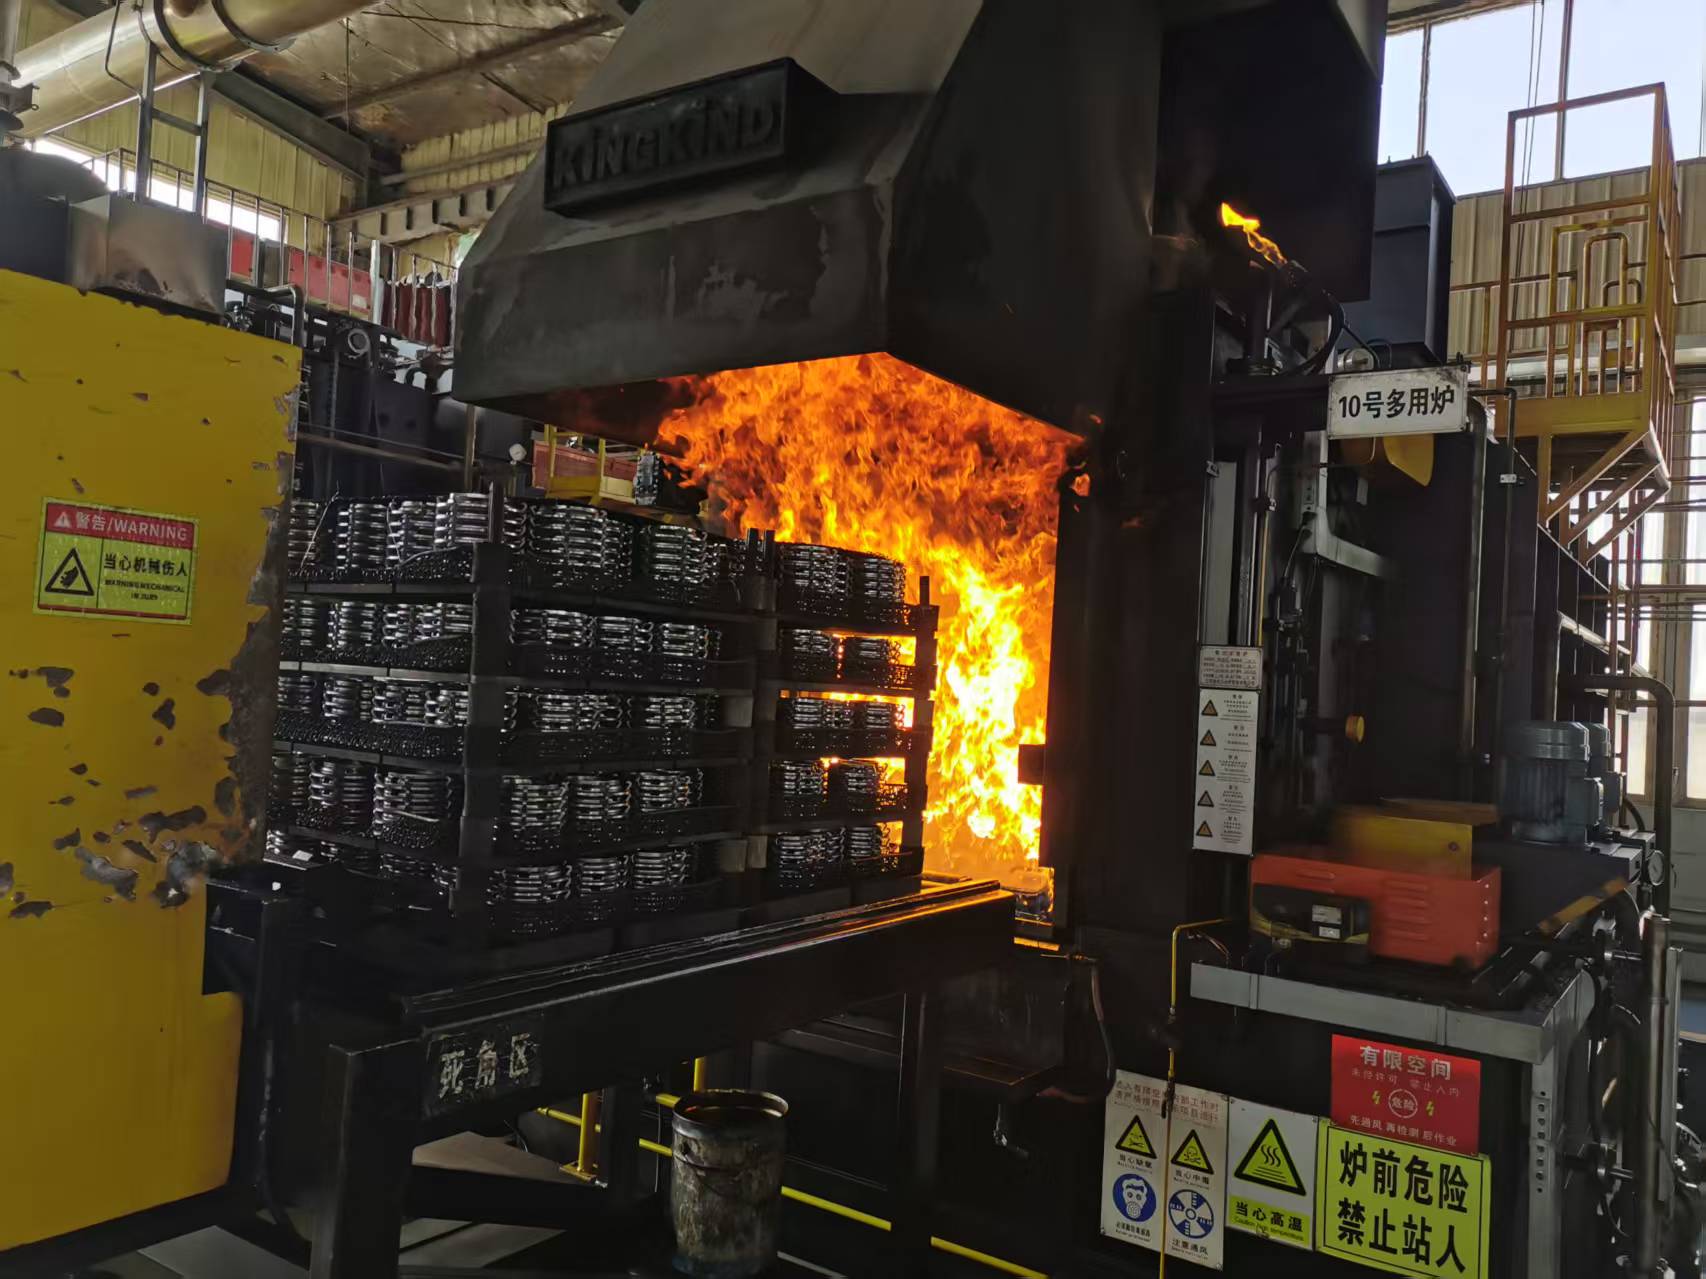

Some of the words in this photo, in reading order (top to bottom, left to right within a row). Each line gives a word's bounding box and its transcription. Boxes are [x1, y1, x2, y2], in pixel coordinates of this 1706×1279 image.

[1338, 384, 1455, 419] 10号多用炉
[103, 552, 188, 577] 当心机械伤人
[1360, 1045, 1451, 1081] 有限空间
[1339, 1140, 1469, 1213] 炉前危险
[1235, 1201, 1303, 1233] 当心高温
[1337, 1197, 1466, 1274] 禁止站人
